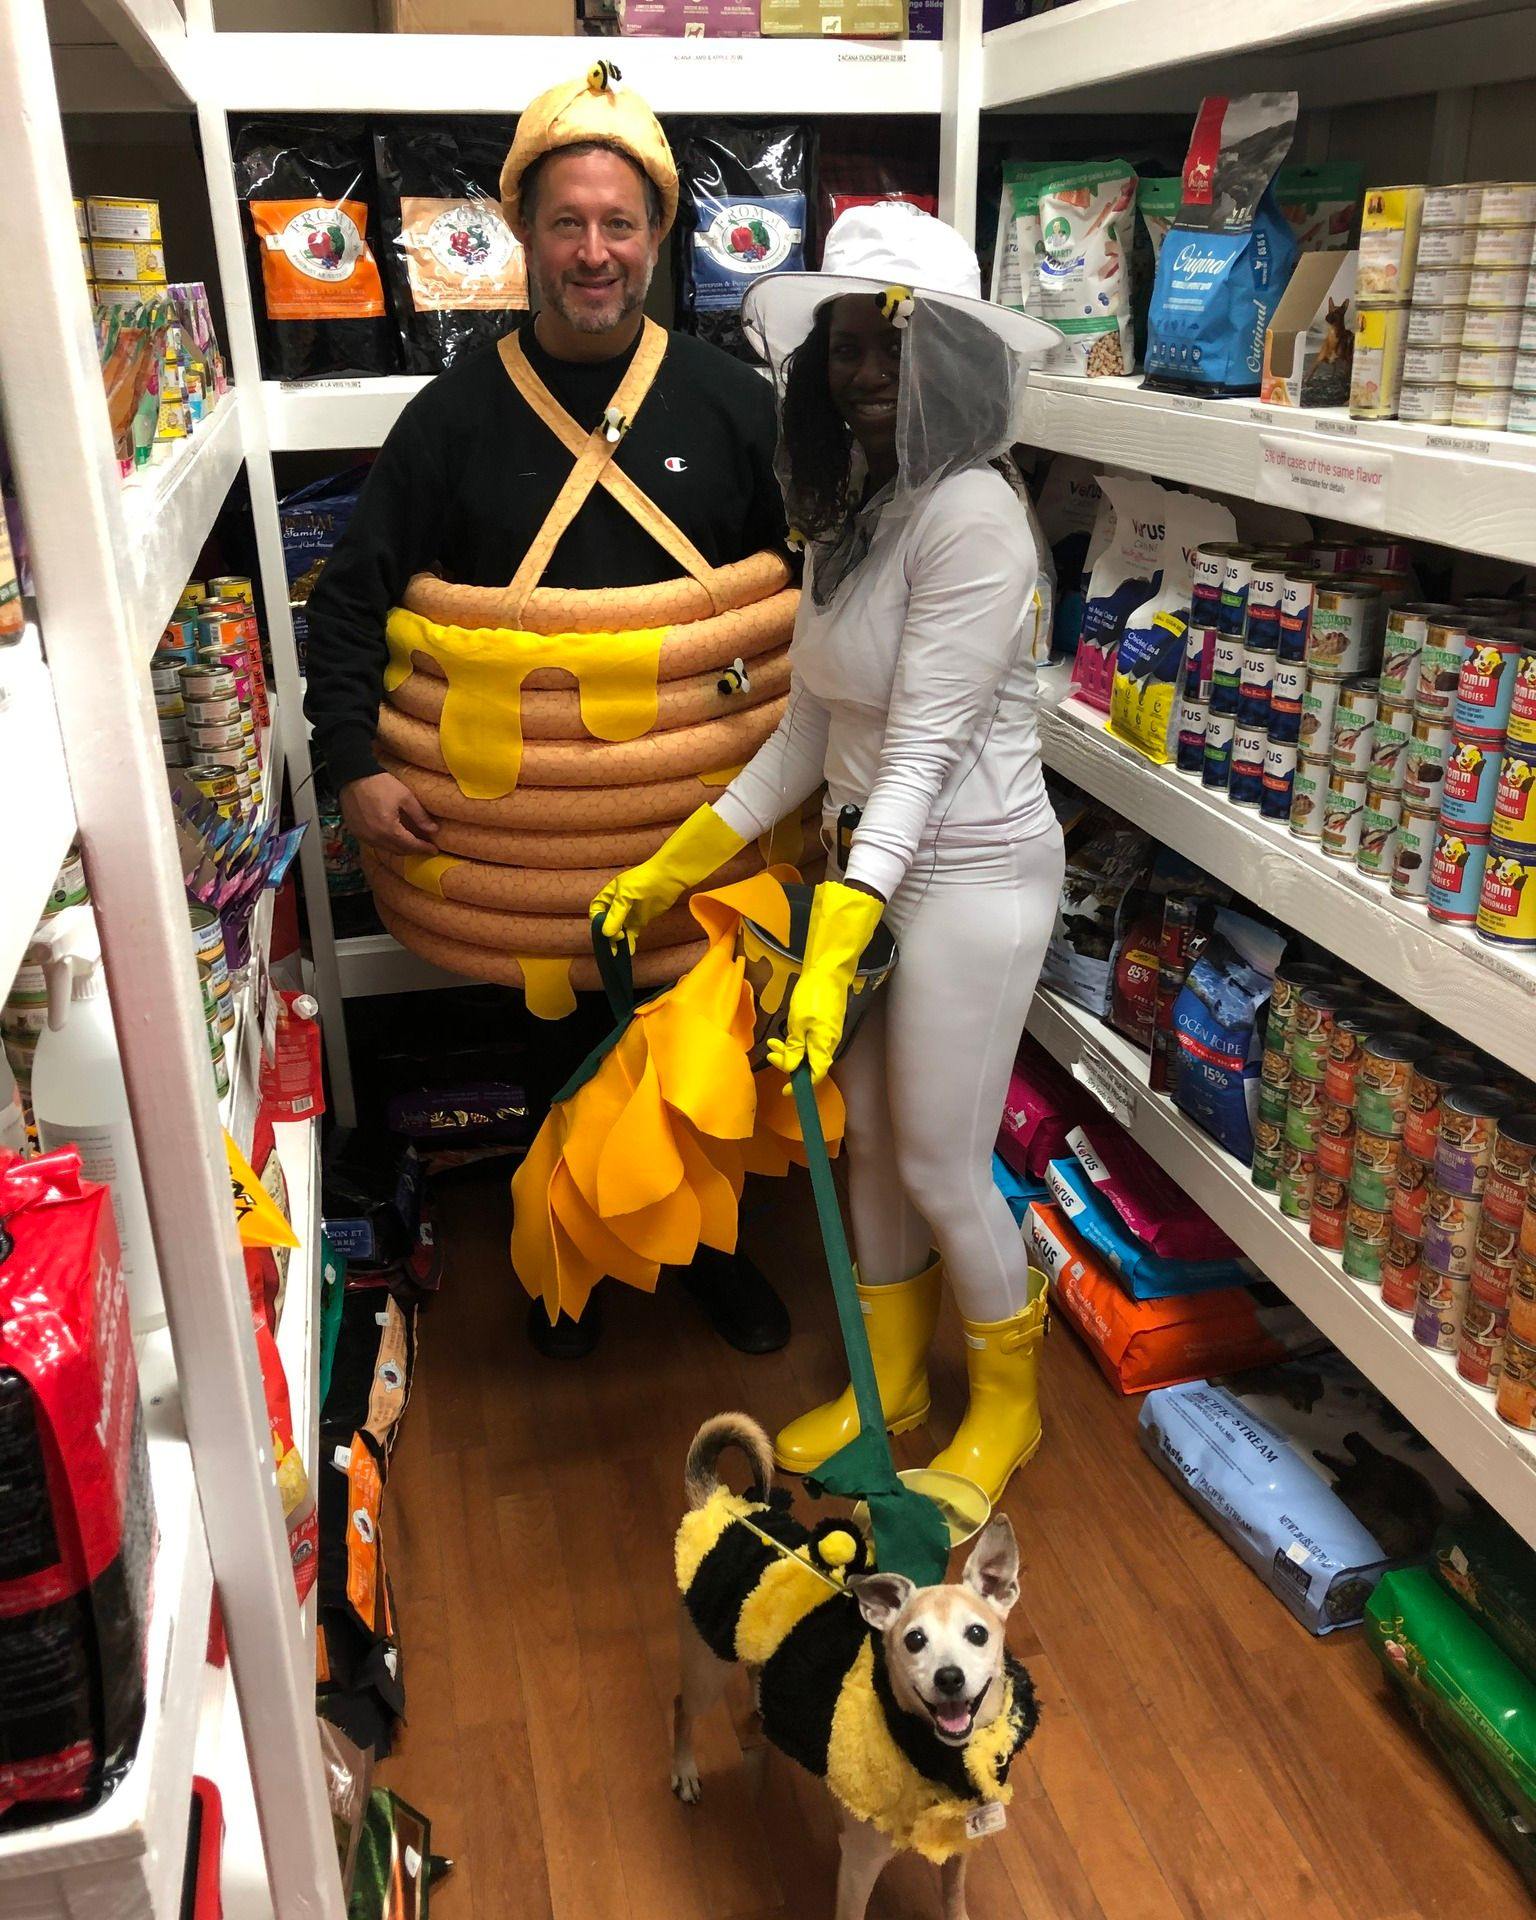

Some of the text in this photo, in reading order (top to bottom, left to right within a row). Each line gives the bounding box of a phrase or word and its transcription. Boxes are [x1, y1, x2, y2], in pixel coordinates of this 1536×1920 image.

[713, 205, 781, 231] FROMM
[1173, 243, 1236, 281] Original
[1246, 299, 1267, 373] Original
[1430, 437, 1451, 447] WERUVA
[1264, 449, 1383, 484] 5% off cases of the same flavor
[1291, 474, 1346, 493] See associate for details
[283, 527, 324, 540] Family
[1132, 518, 1166, 541] Vrus
[1196, 561, 1218, 575] rus
[1249, 579, 1274, 593] rus
[1123, 639, 1139, 655] Brown
[1235, 736, 1260, 751] rus
[1447, 767, 1470, 783] omm
[1498, 785, 1519, 801] omm
[1434, 859, 1455, 874] omm
[1178, 1013, 1209, 1041] OCEN
[1210, 1034, 1242, 1055] RCIPE
[1202, 1064, 1228, 1086] 15%
[1075, 1140, 1099, 1171] Verus
[1052, 1176, 1075, 1208] Verus
[1095, 1314, 1108, 1333] Oats
[1193, 1391, 1279, 1464] PACIFIC STREAM
[1162, 1435, 1199, 1477] Taste of
[1200, 1478, 1252, 1533] PACIFIC STREAM
[1279, 1514, 1291, 1528] NET
